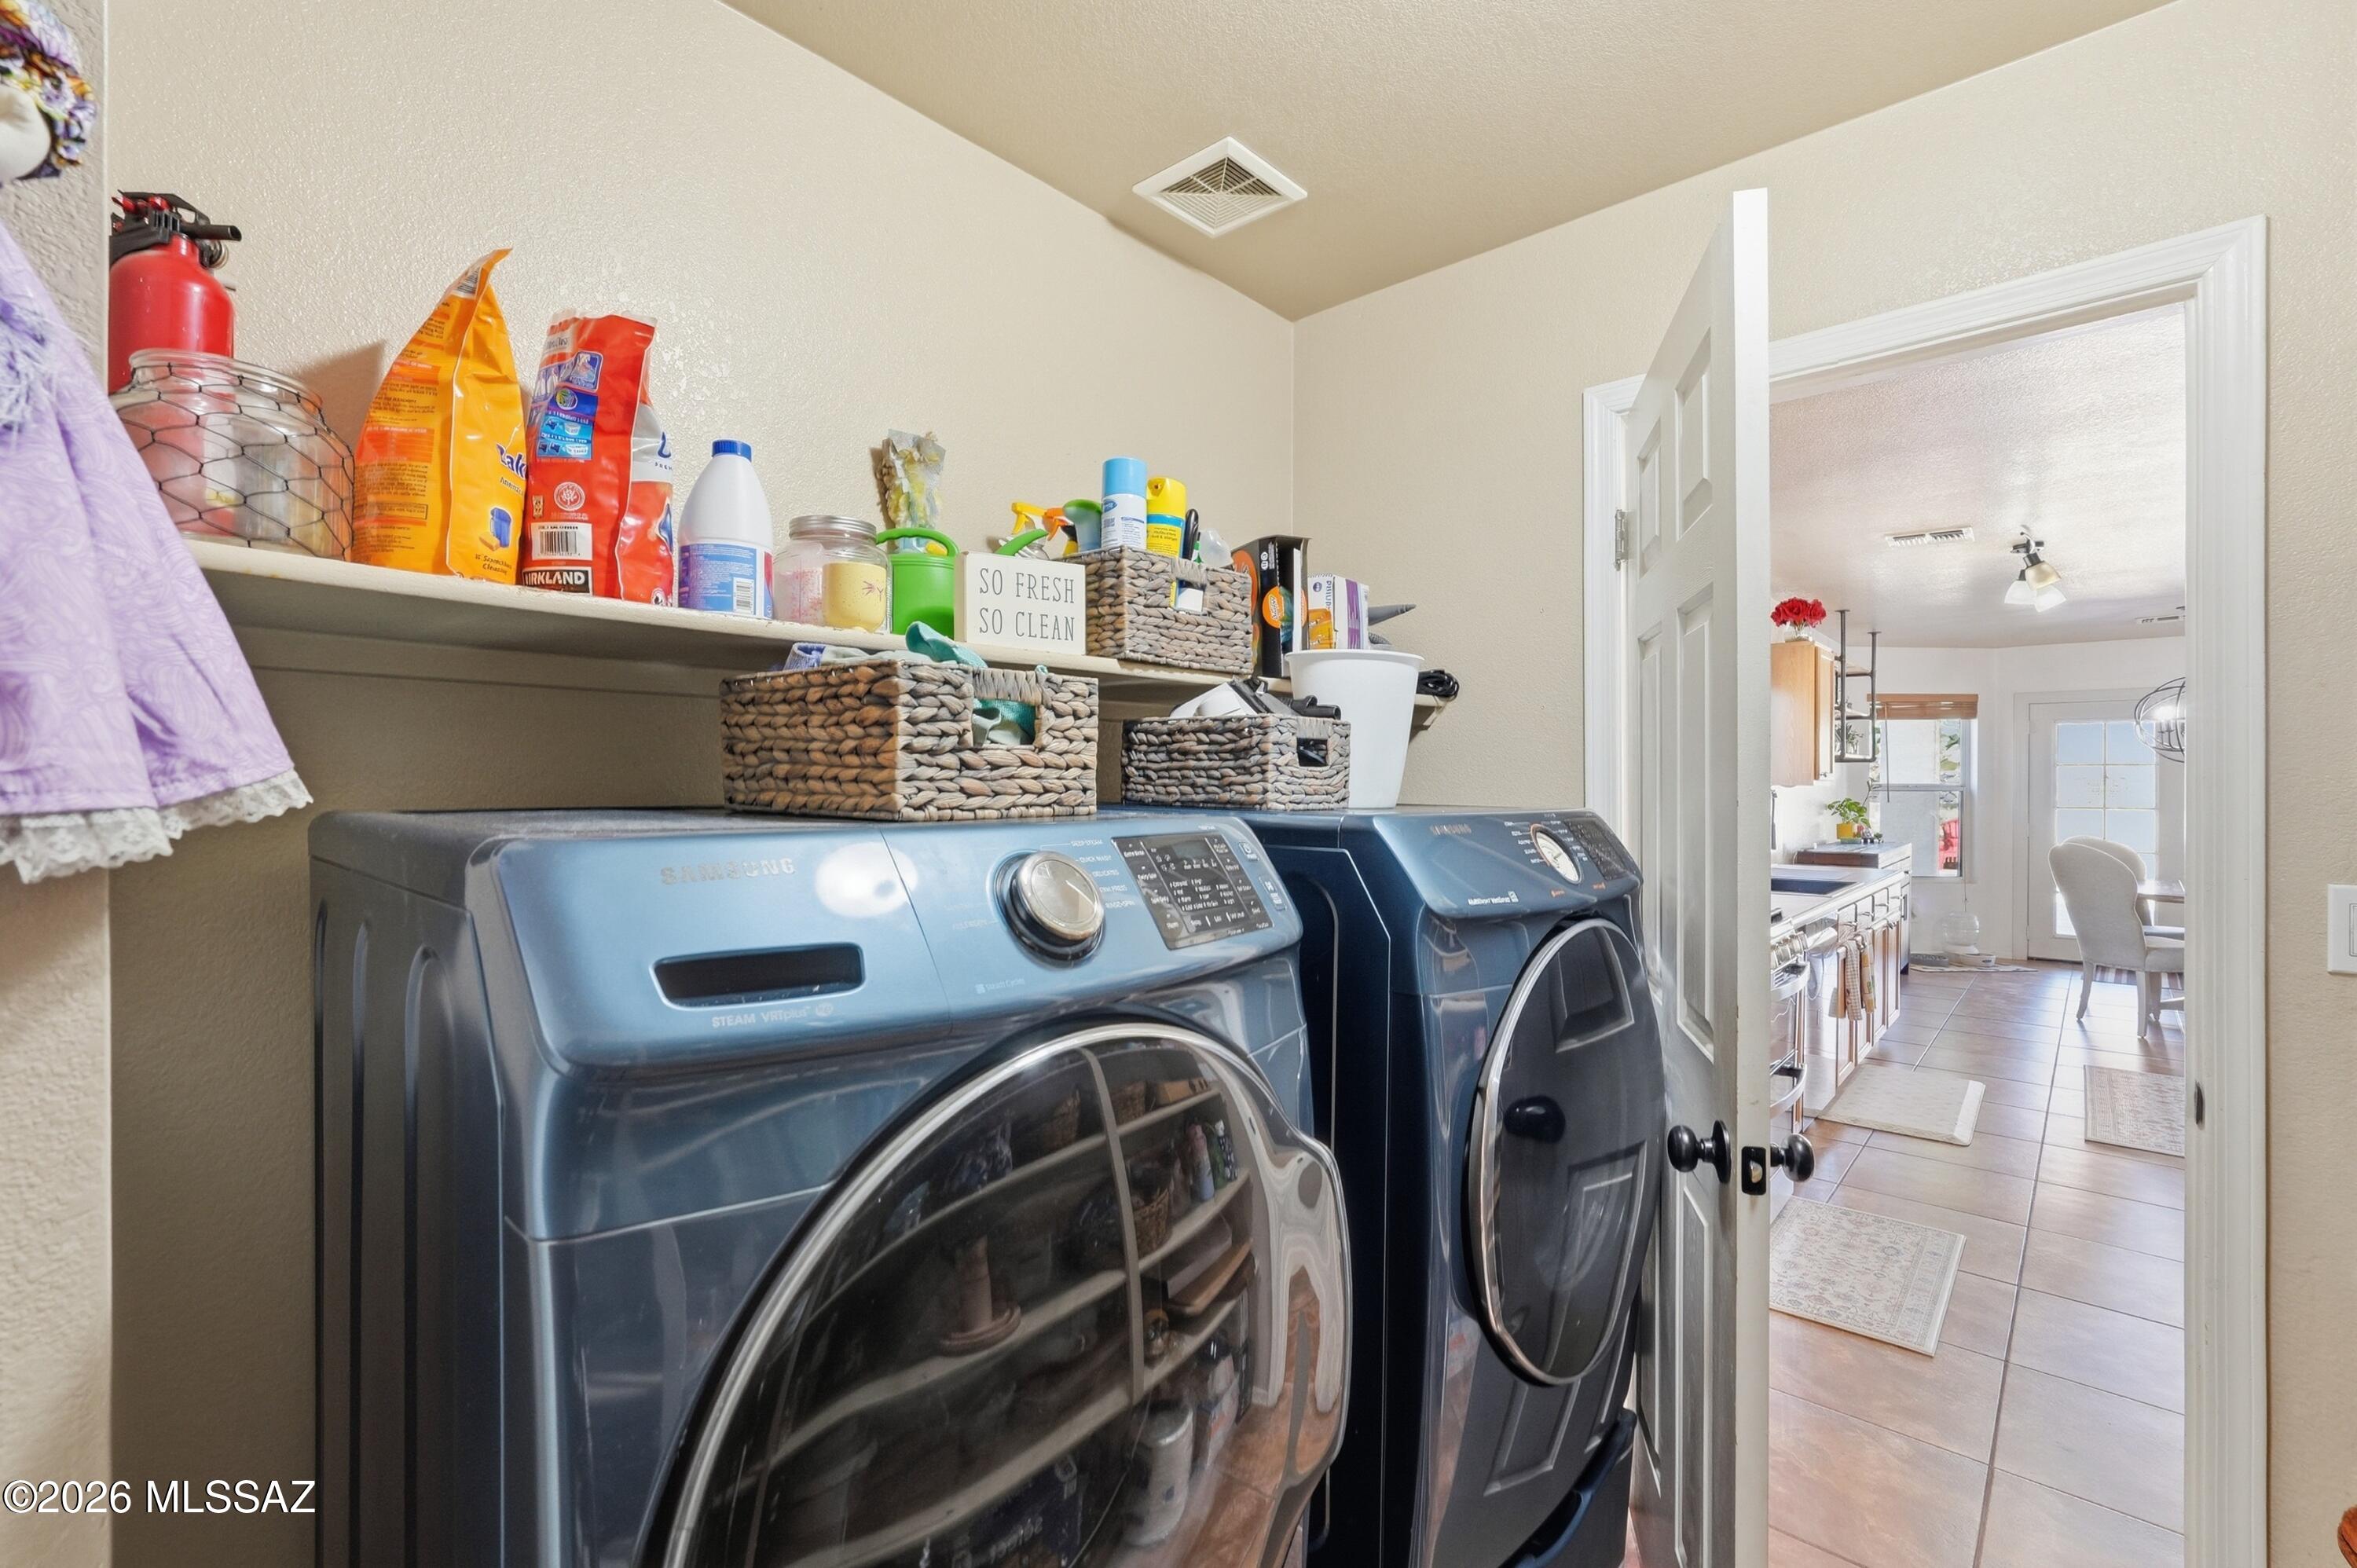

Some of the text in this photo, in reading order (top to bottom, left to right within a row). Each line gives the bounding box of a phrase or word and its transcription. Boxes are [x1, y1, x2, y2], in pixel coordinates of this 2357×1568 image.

[979, 567, 1075, 604] SO FRESH
[979, 606, 1075, 641] SO CLEAN
[660, 857, 795, 885] SAMSUNG
[712, 1013, 756, 1028] STEAM
